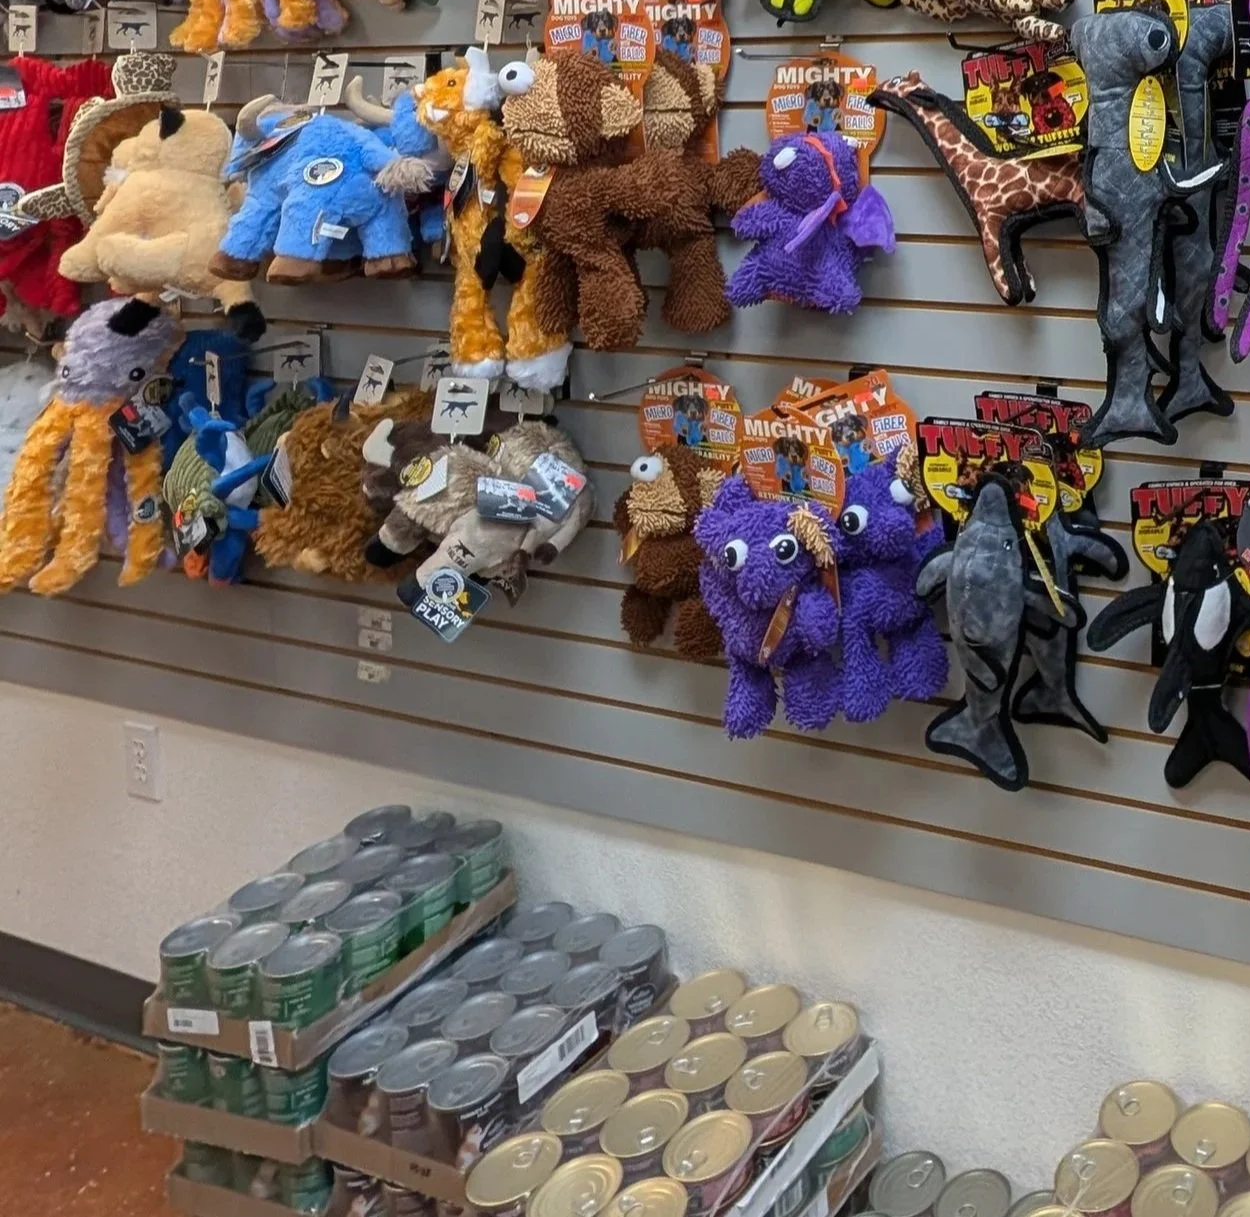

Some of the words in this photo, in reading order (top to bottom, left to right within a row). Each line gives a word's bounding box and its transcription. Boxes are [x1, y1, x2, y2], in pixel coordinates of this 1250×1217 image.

[549, 24, 582, 45] MICRO
[620, 24, 648, 45] FIBER
[699, 27, 723, 50] FIBER
[620, 47, 646, 62] BALLS
[776, 65, 874, 86] MIGHTY
[963, 44, 1045, 88] TUFFY
[618, 73, 643, 81] BILITY
[772, 93, 805, 114] MICRO
[846, 92, 876, 115] FIBER
[842, 113, 875, 131] BALLS
[1037, 126, 1081, 144] TUFFEST
[648, 381, 730, 401] MIGHY
[643, 404, 674, 422] MICRO
[815, 386, 890, 427] GHTY
[976, 398, 1073, 434] TUFFY
[708, 410, 738, 430] FIBER
[870, 414, 908, 434] FIBER
[708, 429, 736, 445] BALLS
[743, 416, 829, 447] MIGHTY
[875, 432, 912, 455] BALLS
[919, 424, 1024, 462] TUFFY
[744, 447, 774, 465] MICRO
[809, 456, 837, 480] FIBER
[810, 475, 837, 496] BALLS
[1132, 486, 1249, 518] TUFFY
[415, 604, 451, 630] PLAY
[422, 595, 465, 629] SENSORY
